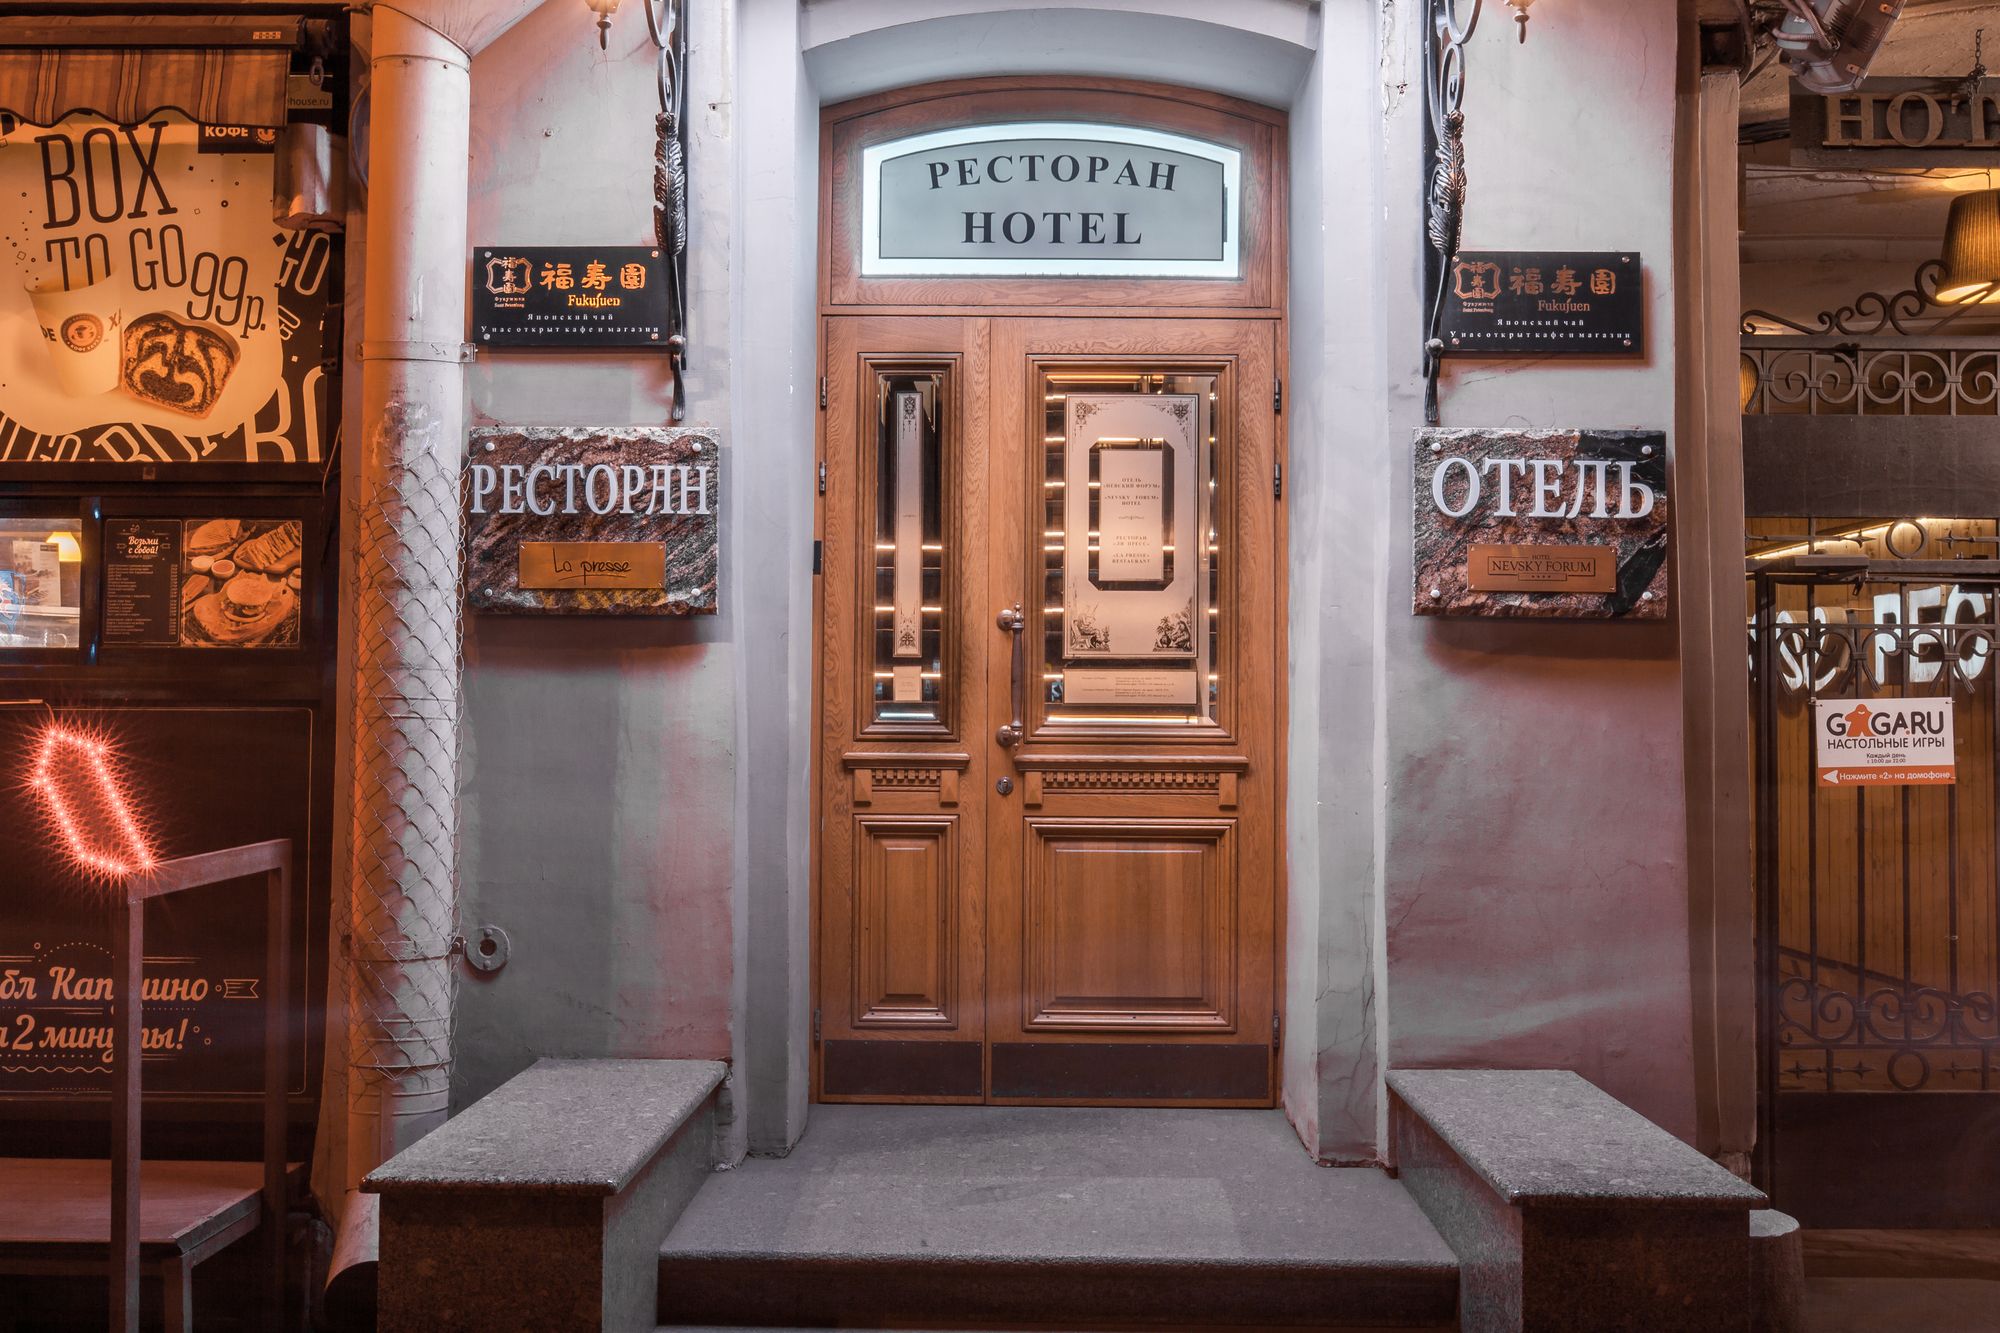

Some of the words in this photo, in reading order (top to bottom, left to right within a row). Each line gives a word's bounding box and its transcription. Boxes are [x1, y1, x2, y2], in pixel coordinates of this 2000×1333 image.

[34, 121, 178, 229] BOX
[925, 154, 1179, 192] РЕСТОРАН
[960, 211, 1142, 245] HOTEL
[129, 224, 187, 292] GO
[567, 293, 621, 309] Fukujuen
[1537, 298, 1591, 314] Fukujuen
[527, 313, 589, 321] Японский
[592, 313, 613, 321] чай
[516, 327, 560, 336] открыт
[564, 325, 594, 334] кафе
[1486, 332, 1531, 340] открыт
[1535, 331, 1564, 340] кафе
[470, 463, 711, 516] РЕСТОРАН
[1432, 457, 1654, 519] ОТЕЛЬ
[128, 535, 160, 549] Возьми
[134, 545, 159, 555] собой!
[552, 546, 573, 573] La
[580, 560, 632, 586] presse
[1492, 560, 1543, 572] NEVSKY
[1546, 561, 1591, 573] FORUM
[1827, 738, 1909, 750] НАСТОЛЬНЫЕ
[1912, 737, 1945, 748] ИГРЫ
[1839, 771, 1878, 781] Нажмите
[1894, 772, 1905, 780] на
[1906, 770, 1951, 780] домофоне
[49, 966, 209, 1001] Капино
[12, 1014, 36, 1051] 2
